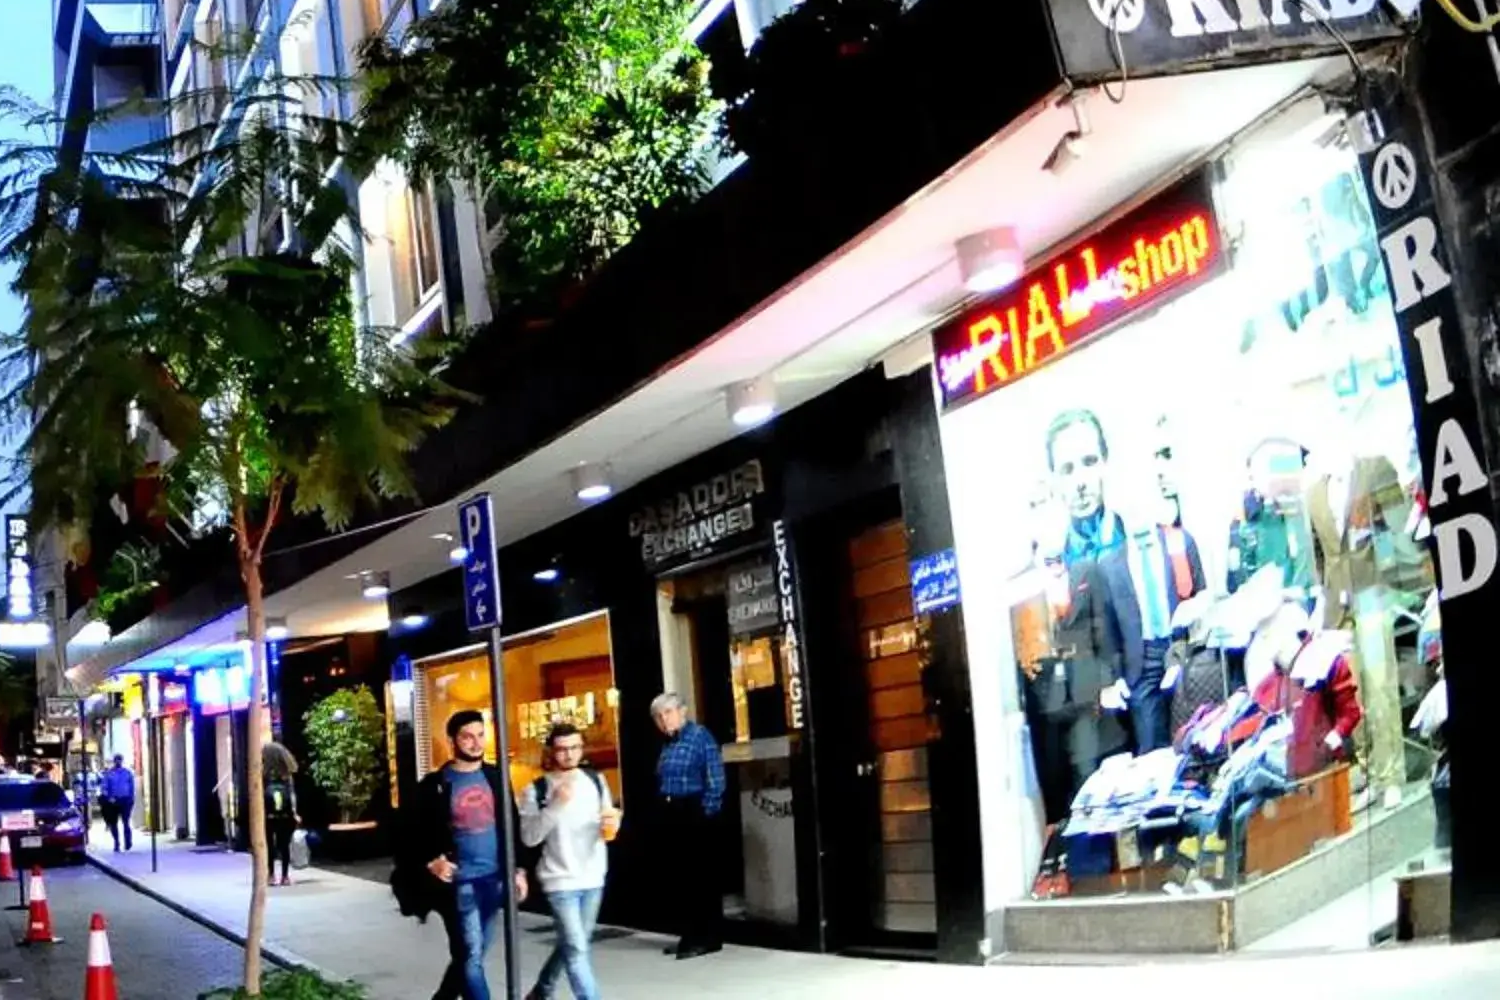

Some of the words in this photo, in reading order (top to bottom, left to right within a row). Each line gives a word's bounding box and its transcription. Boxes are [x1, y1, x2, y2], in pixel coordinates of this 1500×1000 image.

[1117, 215, 1209, 300] shop
[1380, 216, 1497, 601] RIAD
[466, 505, 481, 553] P
[773, 519, 804, 729] EXCHANGE
